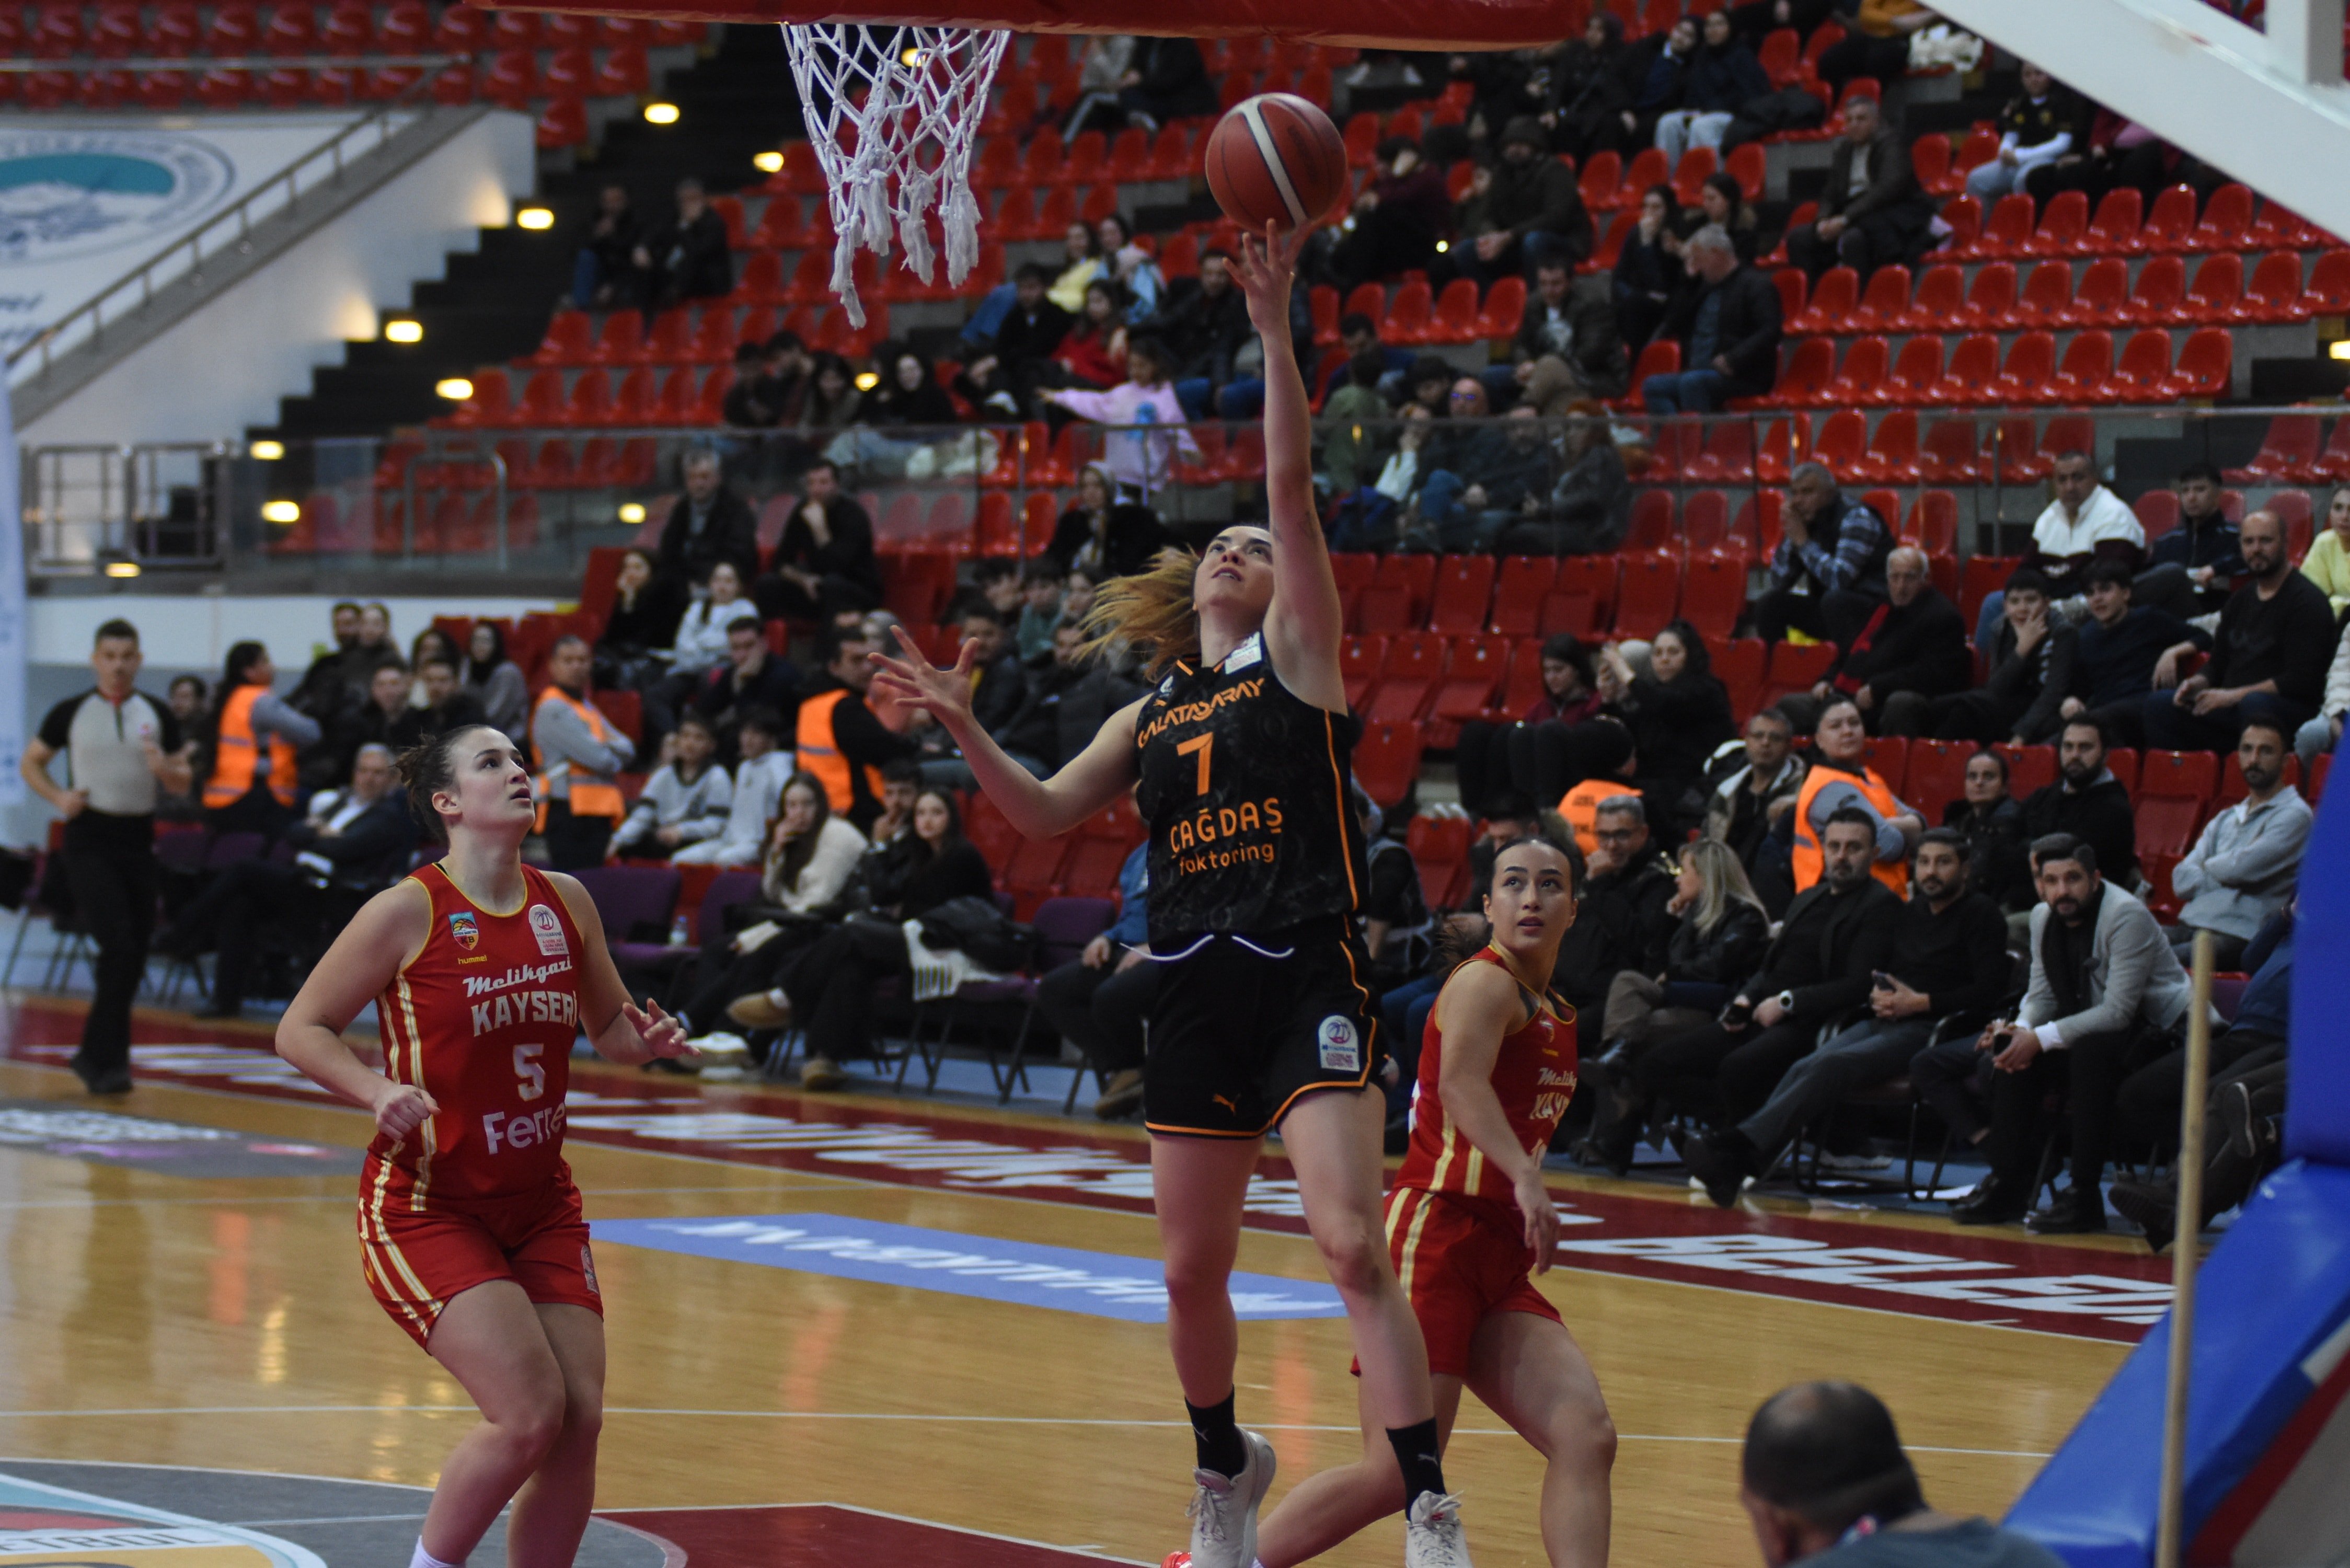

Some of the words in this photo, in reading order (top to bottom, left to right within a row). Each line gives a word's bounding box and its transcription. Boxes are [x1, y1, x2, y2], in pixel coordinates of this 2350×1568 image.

[1137, 677, 1265, 749] GALATASARAY
[1176, 732, 1214, 796] 7
[1179, 841, 1275, 877] faktoring
[457, 954, 488, 965] hummel
[462, 955, 573, 998] Melikgazi
[513, 1043, 546, 1102] 5
[482, 1102, 566, 1155] Ferre
